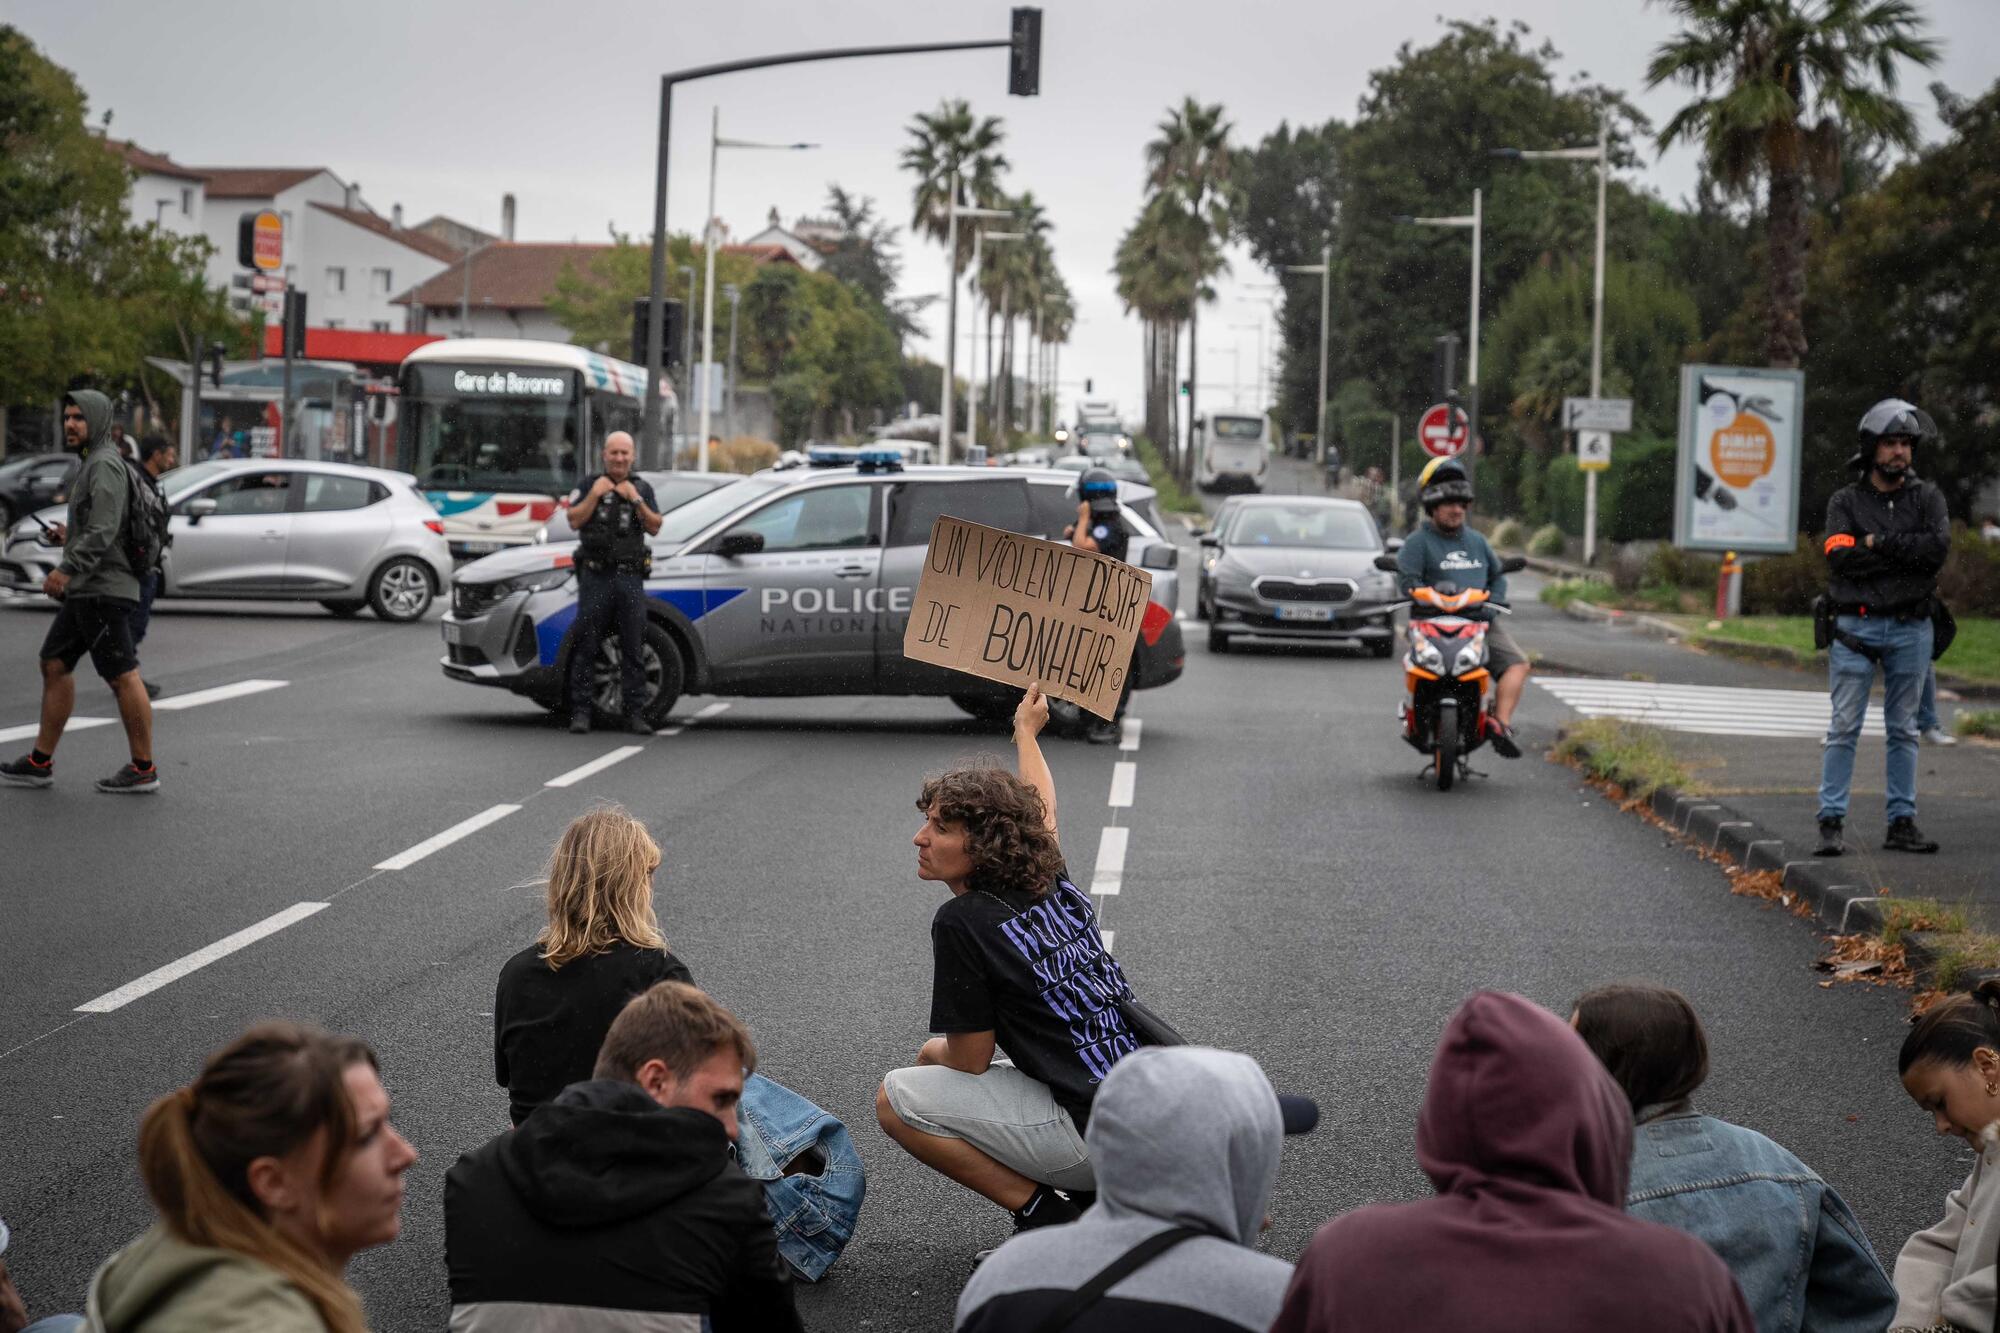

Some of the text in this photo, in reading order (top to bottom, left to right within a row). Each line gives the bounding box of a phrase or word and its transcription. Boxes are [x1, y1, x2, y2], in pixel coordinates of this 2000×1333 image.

[455, 370, 487, 392] Gare
[487, 371, 506, 393] de
[932, 522, 971, 577] UN
[761, 587, 911, 613] POLICE
[918, 601, 1115, 702] DE BONHEUR
